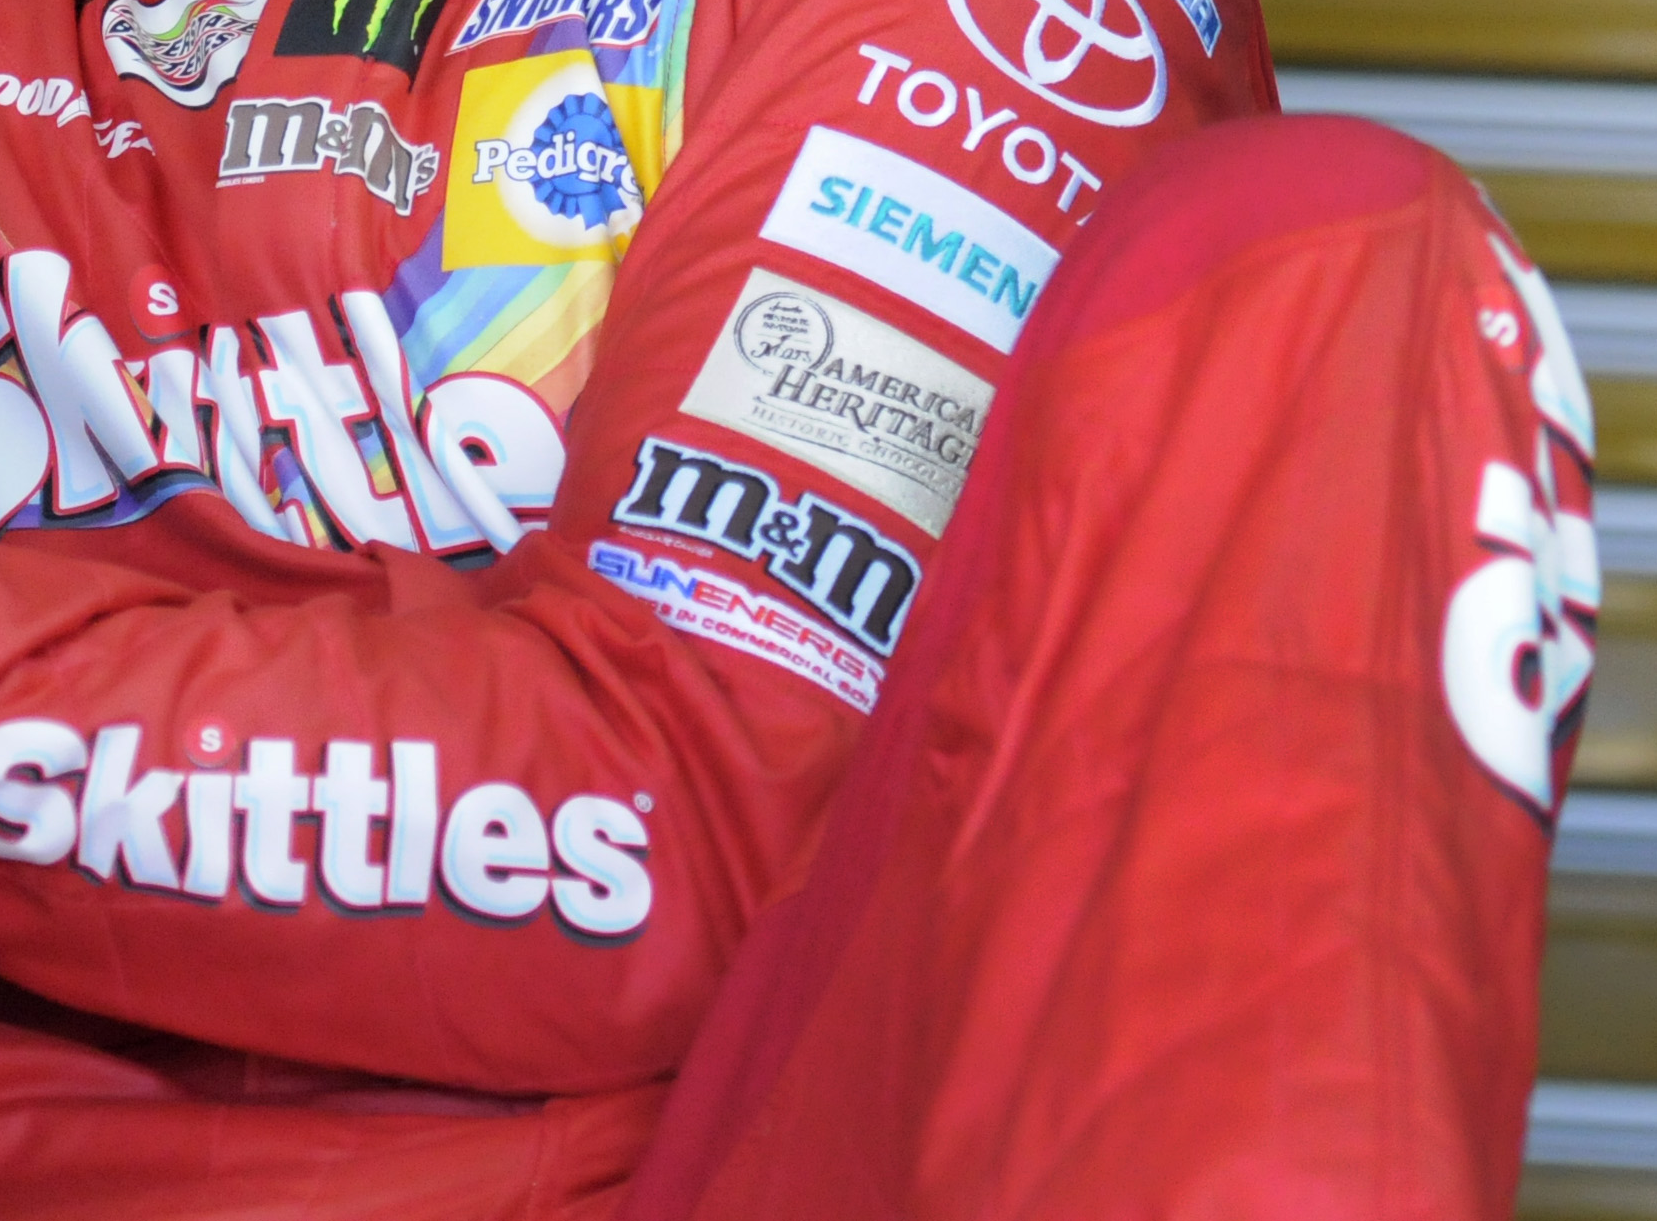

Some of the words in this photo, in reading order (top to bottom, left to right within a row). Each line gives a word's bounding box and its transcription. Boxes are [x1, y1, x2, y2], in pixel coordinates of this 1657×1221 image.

[472, 131, 641, 196] Pedigre
[857, 43, 1102, 226] TOYOT
[810, 176, 1038, 319] SIEMEN
[768, 364, 972, 471] HERITAG
[823, 357, 984, 439] AMERICA
